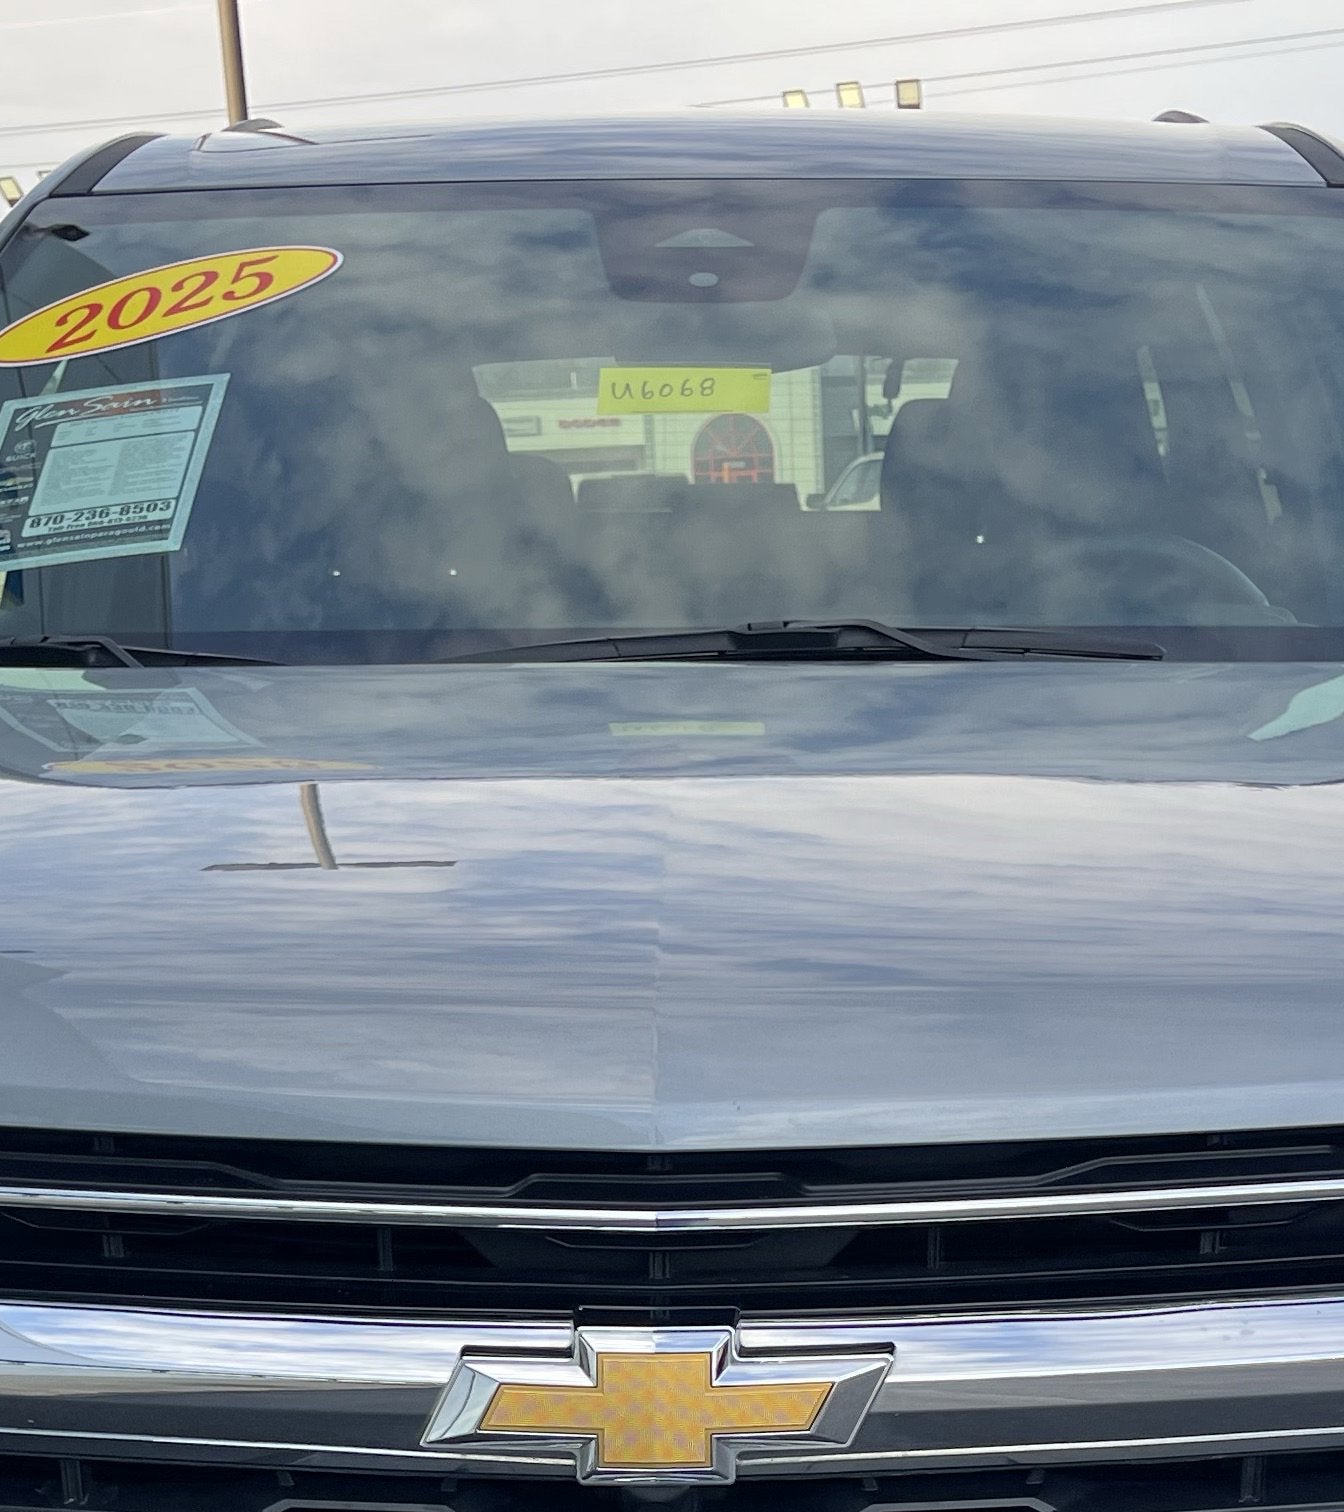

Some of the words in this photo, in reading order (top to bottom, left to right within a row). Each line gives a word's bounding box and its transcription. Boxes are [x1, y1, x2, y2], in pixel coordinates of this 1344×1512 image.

[46, 255, 279, 354] 2025
[611, 378, 716, 400] U6068
[15, 403, 80, 431] Glen
[80, 395, 156, 417] Sain
[29, 500, 172, 528] 870-236-8503
